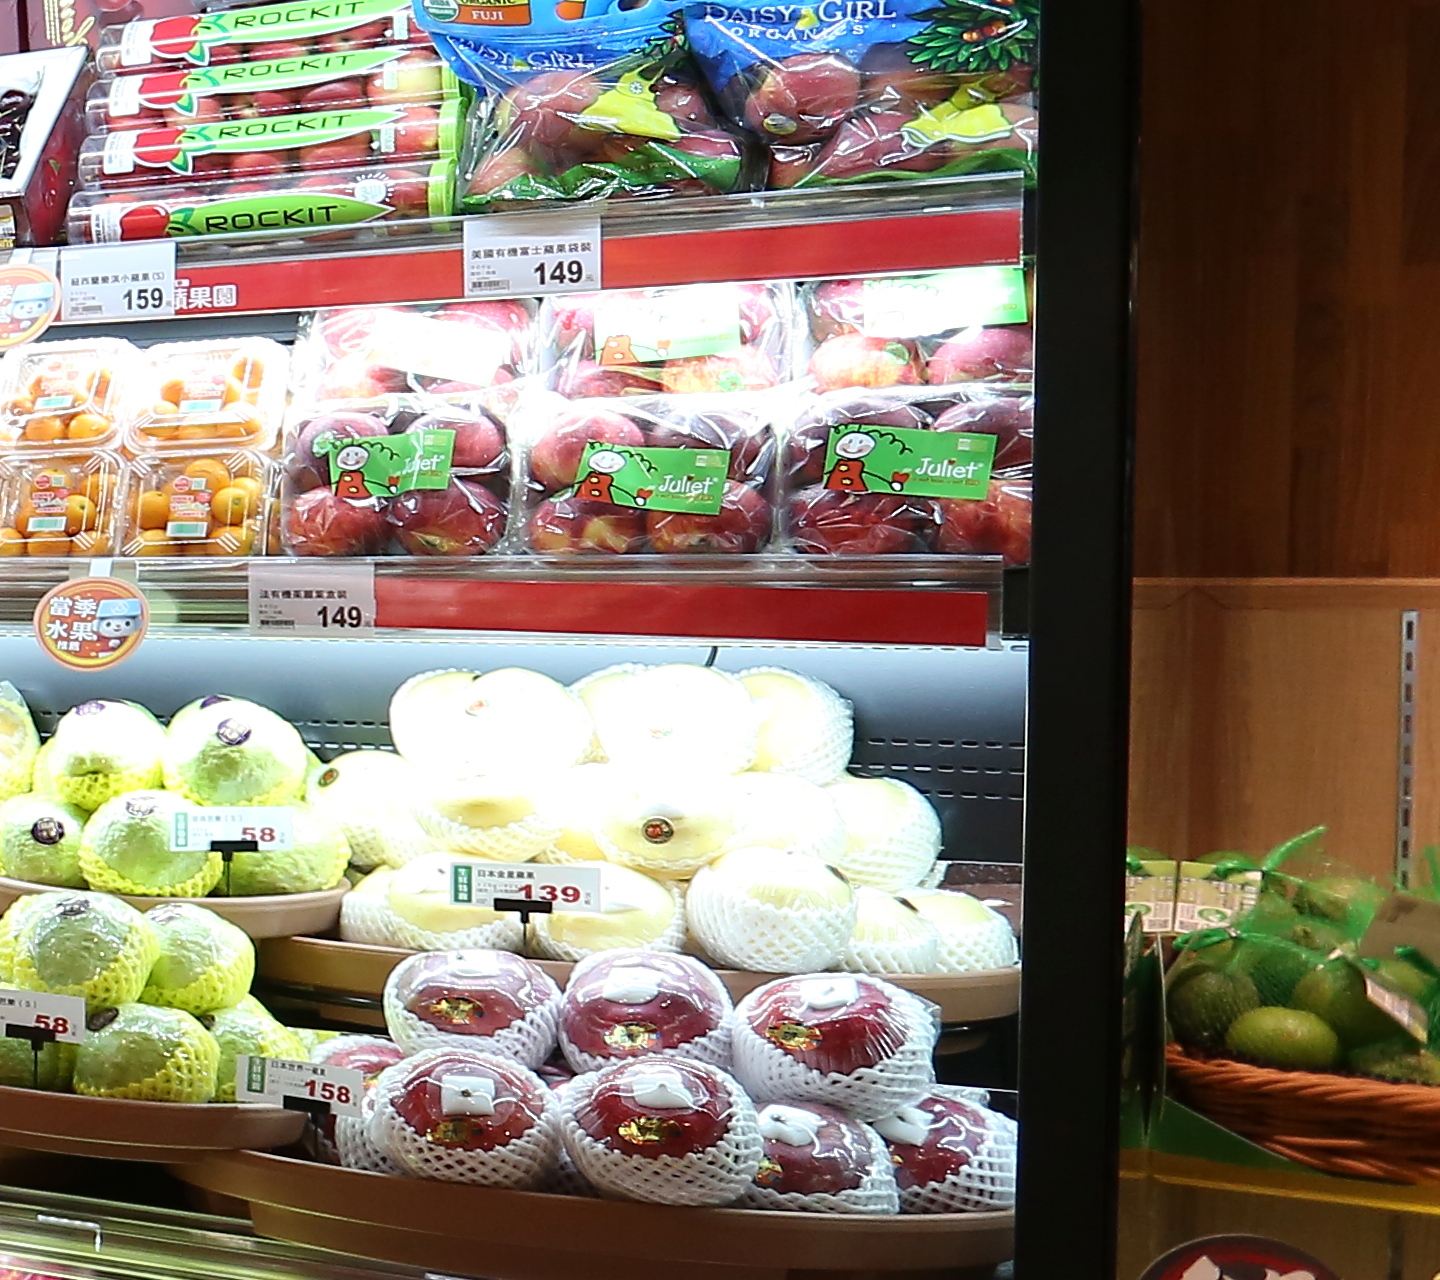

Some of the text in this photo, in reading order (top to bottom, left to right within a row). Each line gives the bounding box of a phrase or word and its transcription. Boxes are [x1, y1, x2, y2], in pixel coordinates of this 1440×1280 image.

[236, 1, 366, 27] ROCKIT
[471, 9, 504, 22] FUJI
[705, 3, 797, 25] DAISY
[223, 54, 355, 80] ROCKIT
[218, 115, 351, 139] ROCKIT
[205, 205, 340, 233] ROCKIT
[471, 241, 593, 261] 美國有機富士蘋果袋裝
[532, 260, 585, 288] 149
[123, 287, 164, 311] 159
[915, 456, 982, 481] Juliet
[659, 474, 713, 496] Juliet
[49, 596, 98, 617] 當季
[316, 606, 363, 630] 149
[44, 619, 98, 642] 水果
[240, 826, 277, 843] 58
[517, 883, 582, 904] 139
[33, 1013, 71, 1035] 58
[303, 1079, 352, 1105] 158
